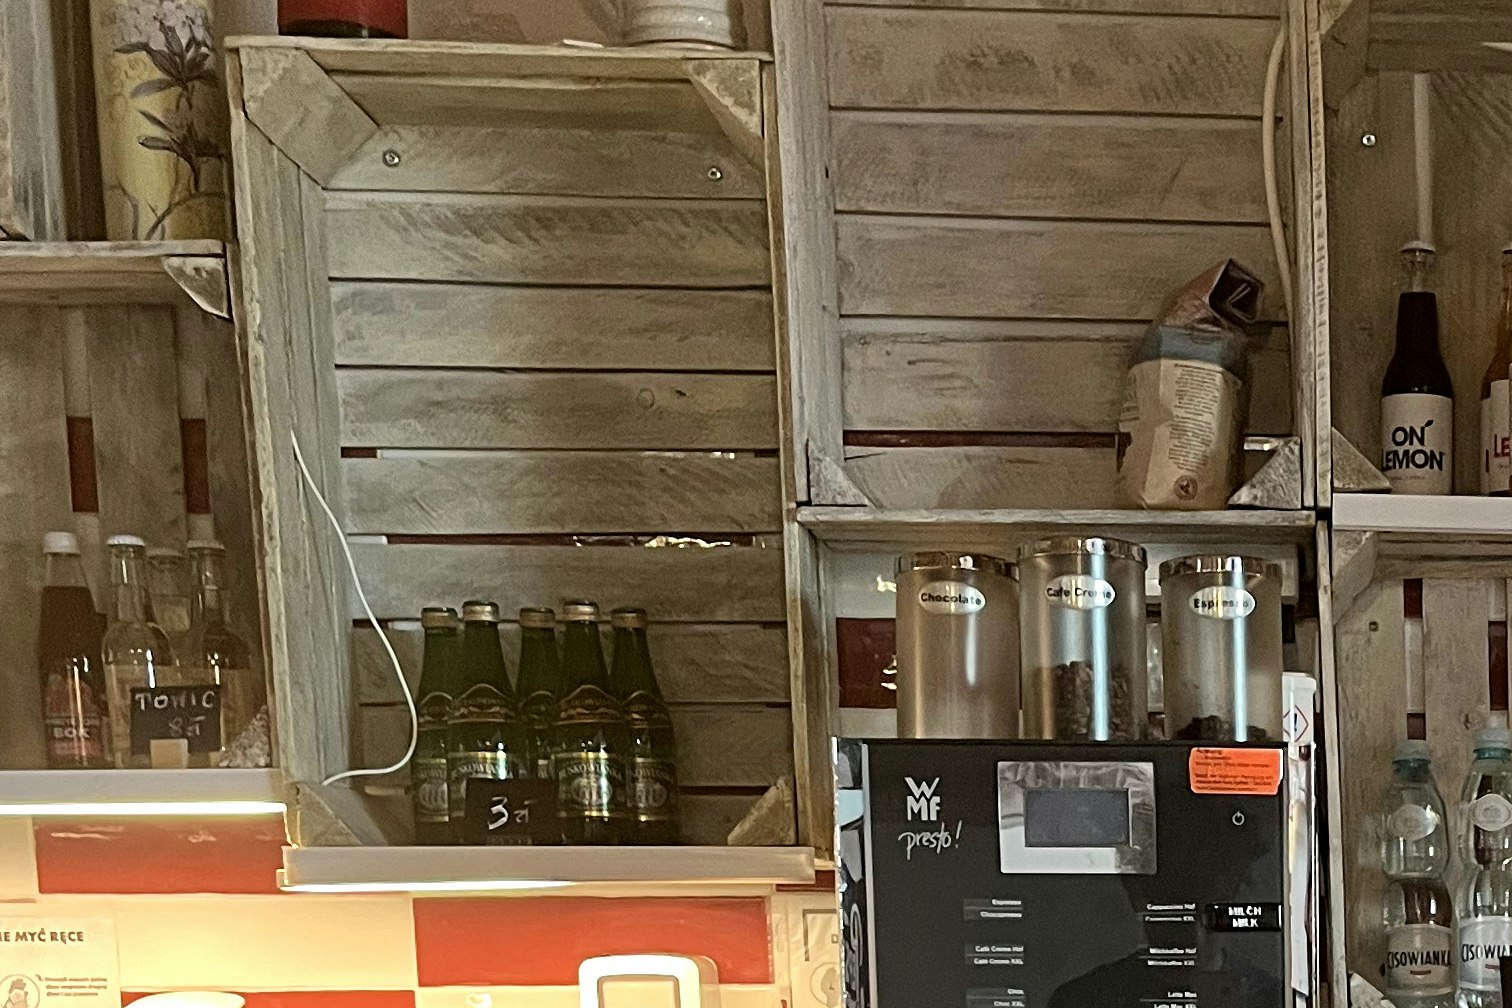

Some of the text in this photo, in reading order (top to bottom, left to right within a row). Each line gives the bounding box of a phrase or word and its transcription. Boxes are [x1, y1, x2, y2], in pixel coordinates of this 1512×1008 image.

[1392, 426, 1426, 447] ON
[1382, 449, 1445, 472] LEMON
[921, 592, 982, 606] Chocolate
[1193, 598, 1249, 610] Espreso
[135, 690, 216, 711] TONIC
[898, 820, 962, 860] presto!
[15, 928, 47, 943] MYĆ
[50, 931, 84, 945] RĘCE
